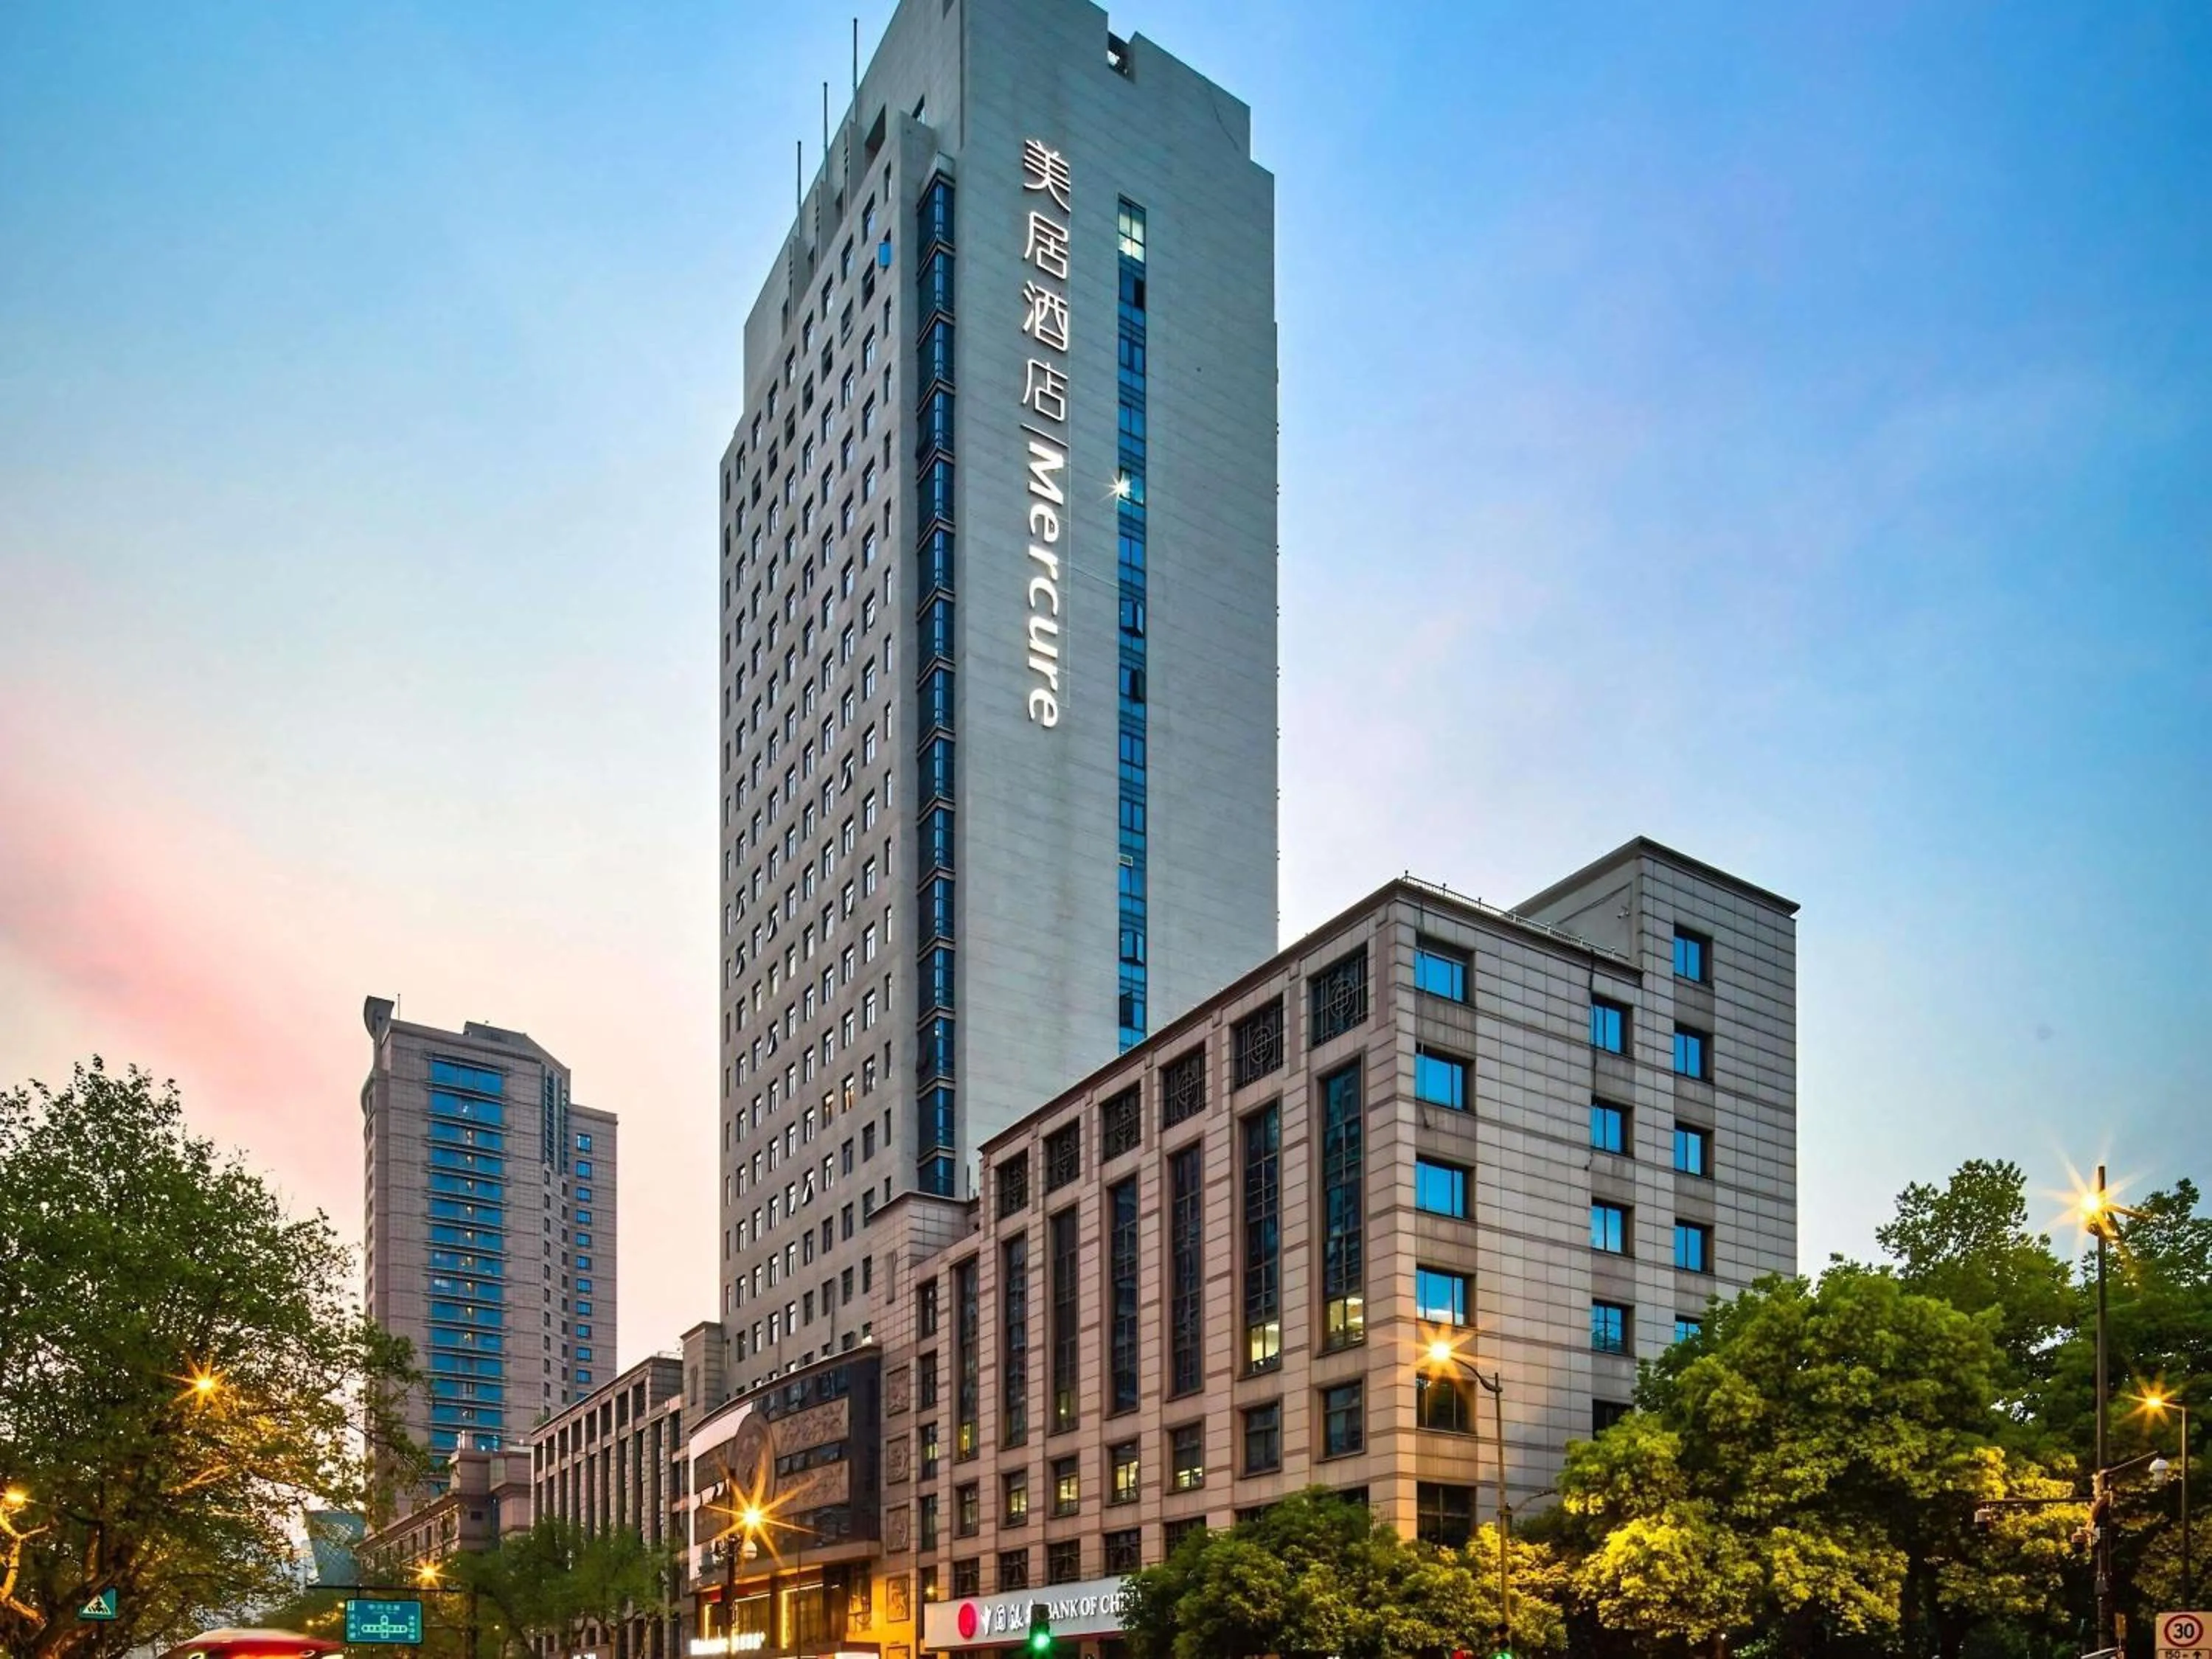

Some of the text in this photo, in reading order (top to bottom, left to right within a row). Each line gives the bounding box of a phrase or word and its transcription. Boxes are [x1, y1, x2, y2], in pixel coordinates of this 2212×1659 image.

[1022, 139, 1071, 422] 美居酒店
[1028, 441, 1064, 729] Mercure
[1044, 1599, 1078, 1620] BANK
[1080, 1596, 1098, 1615] OF
[2173, 1623, 2195, 1638] 30
